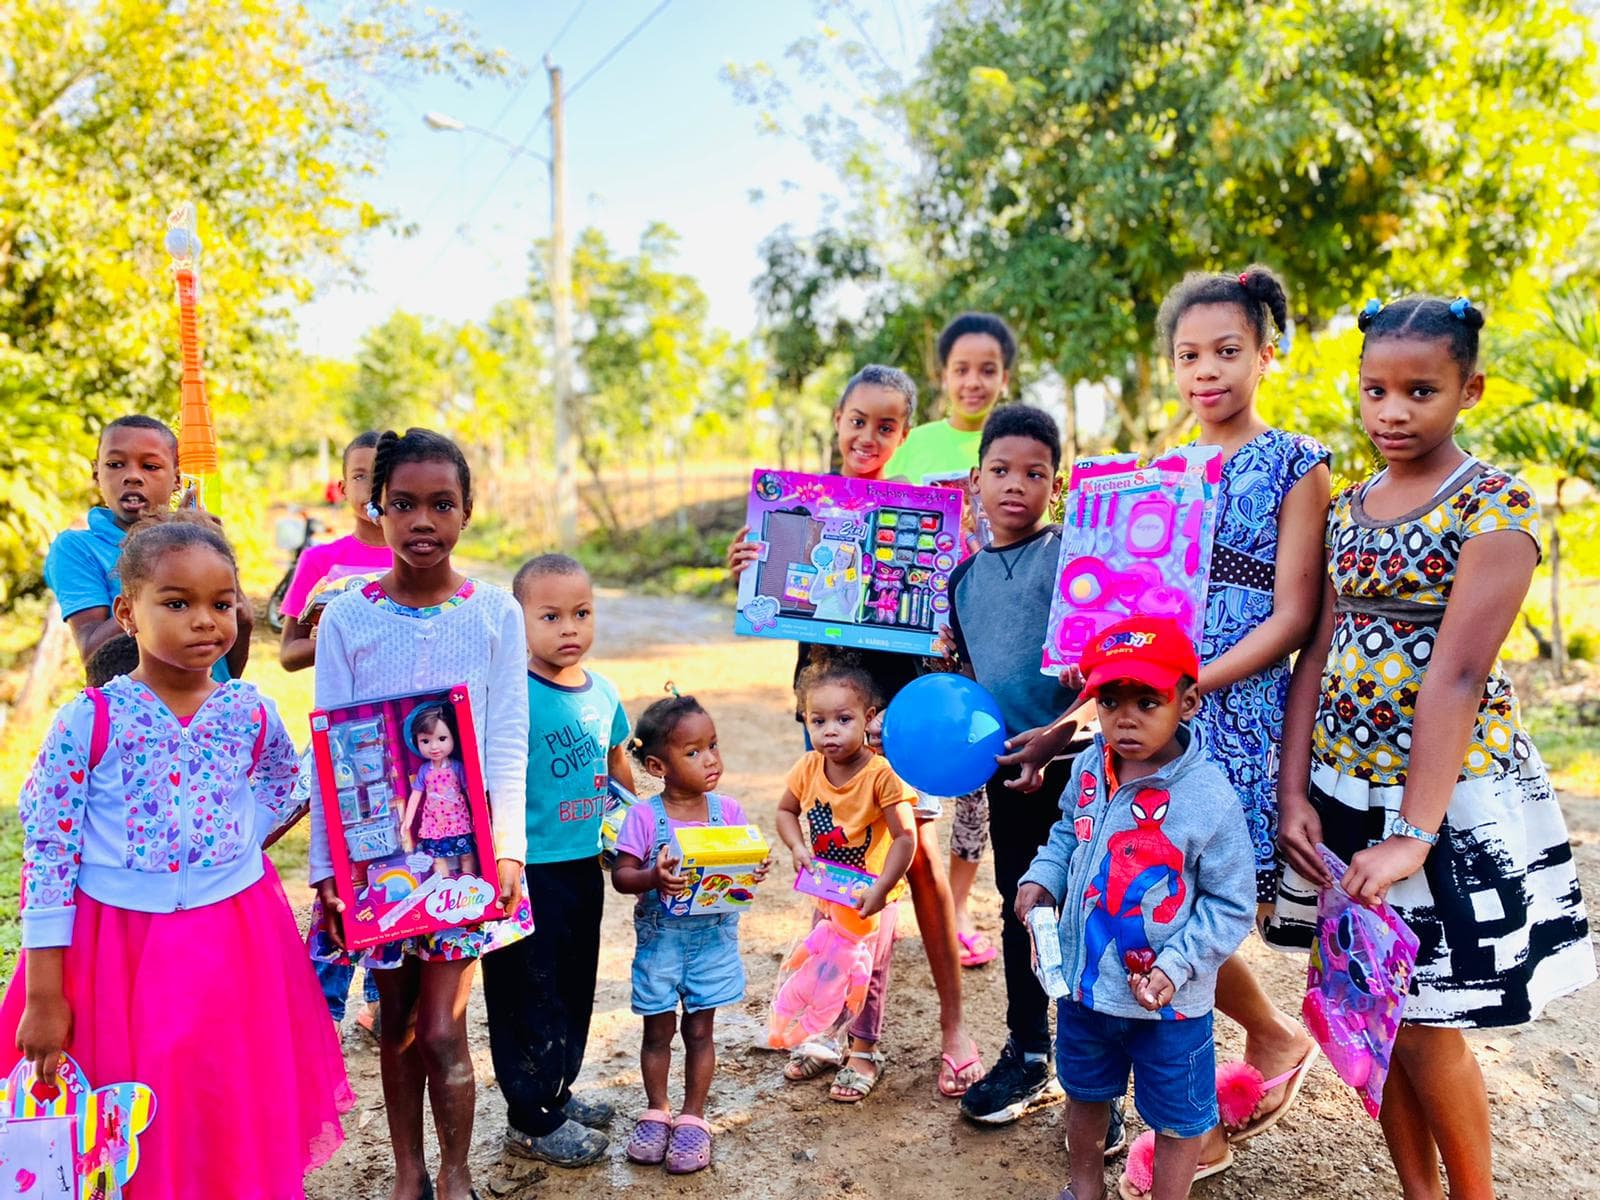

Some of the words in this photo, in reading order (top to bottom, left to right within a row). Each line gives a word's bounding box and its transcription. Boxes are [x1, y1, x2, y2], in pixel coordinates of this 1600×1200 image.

[1083, 479, 1131, 493] Kitchen
[545, 719, 589, 755] PULL
[436, 888, 485, 913] Jelena
